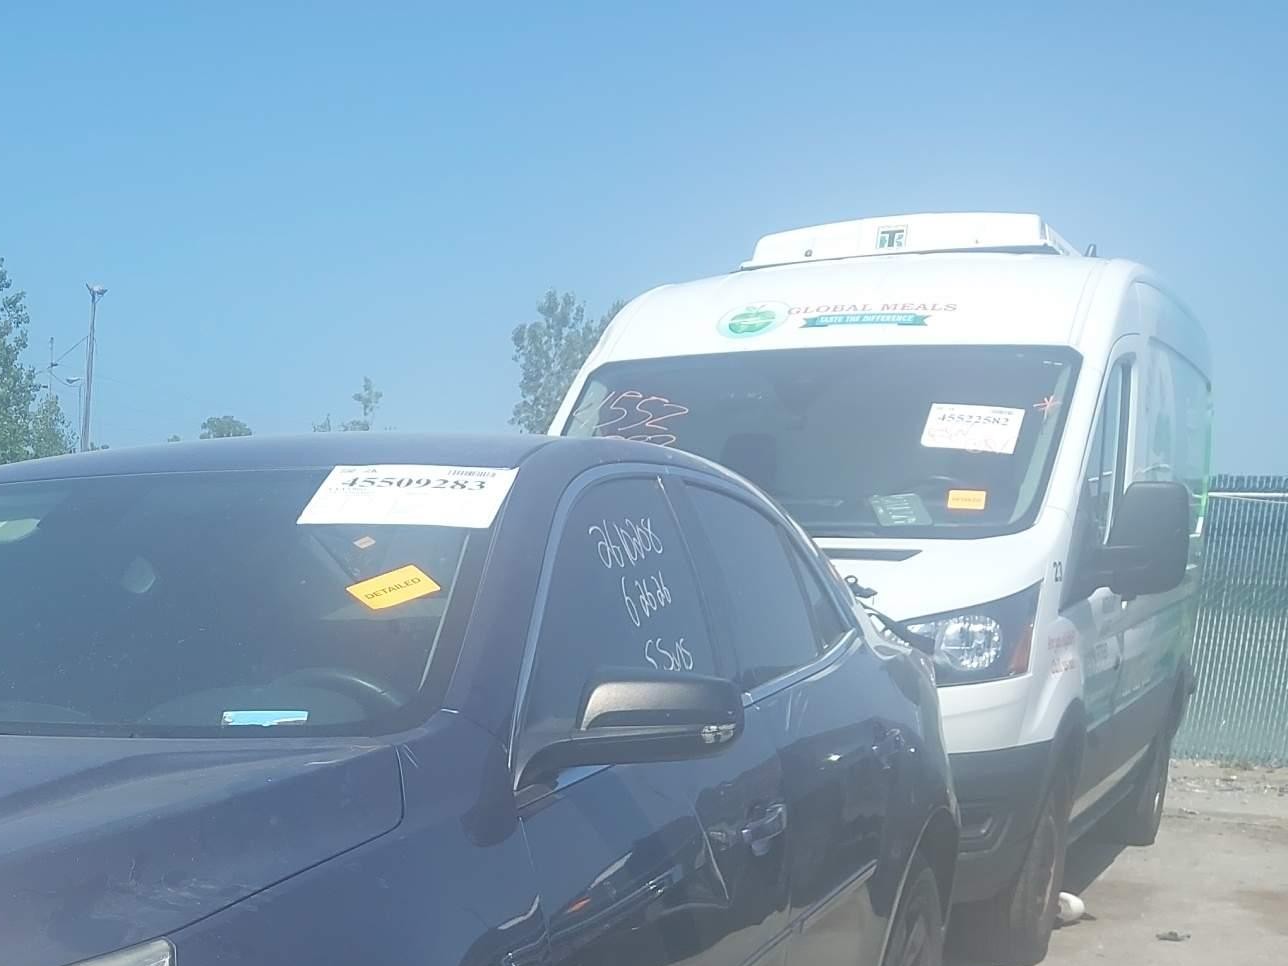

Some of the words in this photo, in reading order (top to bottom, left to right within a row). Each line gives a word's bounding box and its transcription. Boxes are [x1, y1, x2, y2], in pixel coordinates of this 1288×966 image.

[787, 303, 871, 315] GLOBAL
[880, 303, 959, 313] MEALS
[936, 413, 1010, 426] 45522582
[341, 476, 486, 491] 45509283
[1053, 560, 1063, 582] 23
[364, 576, 422, 600] DETAILED
